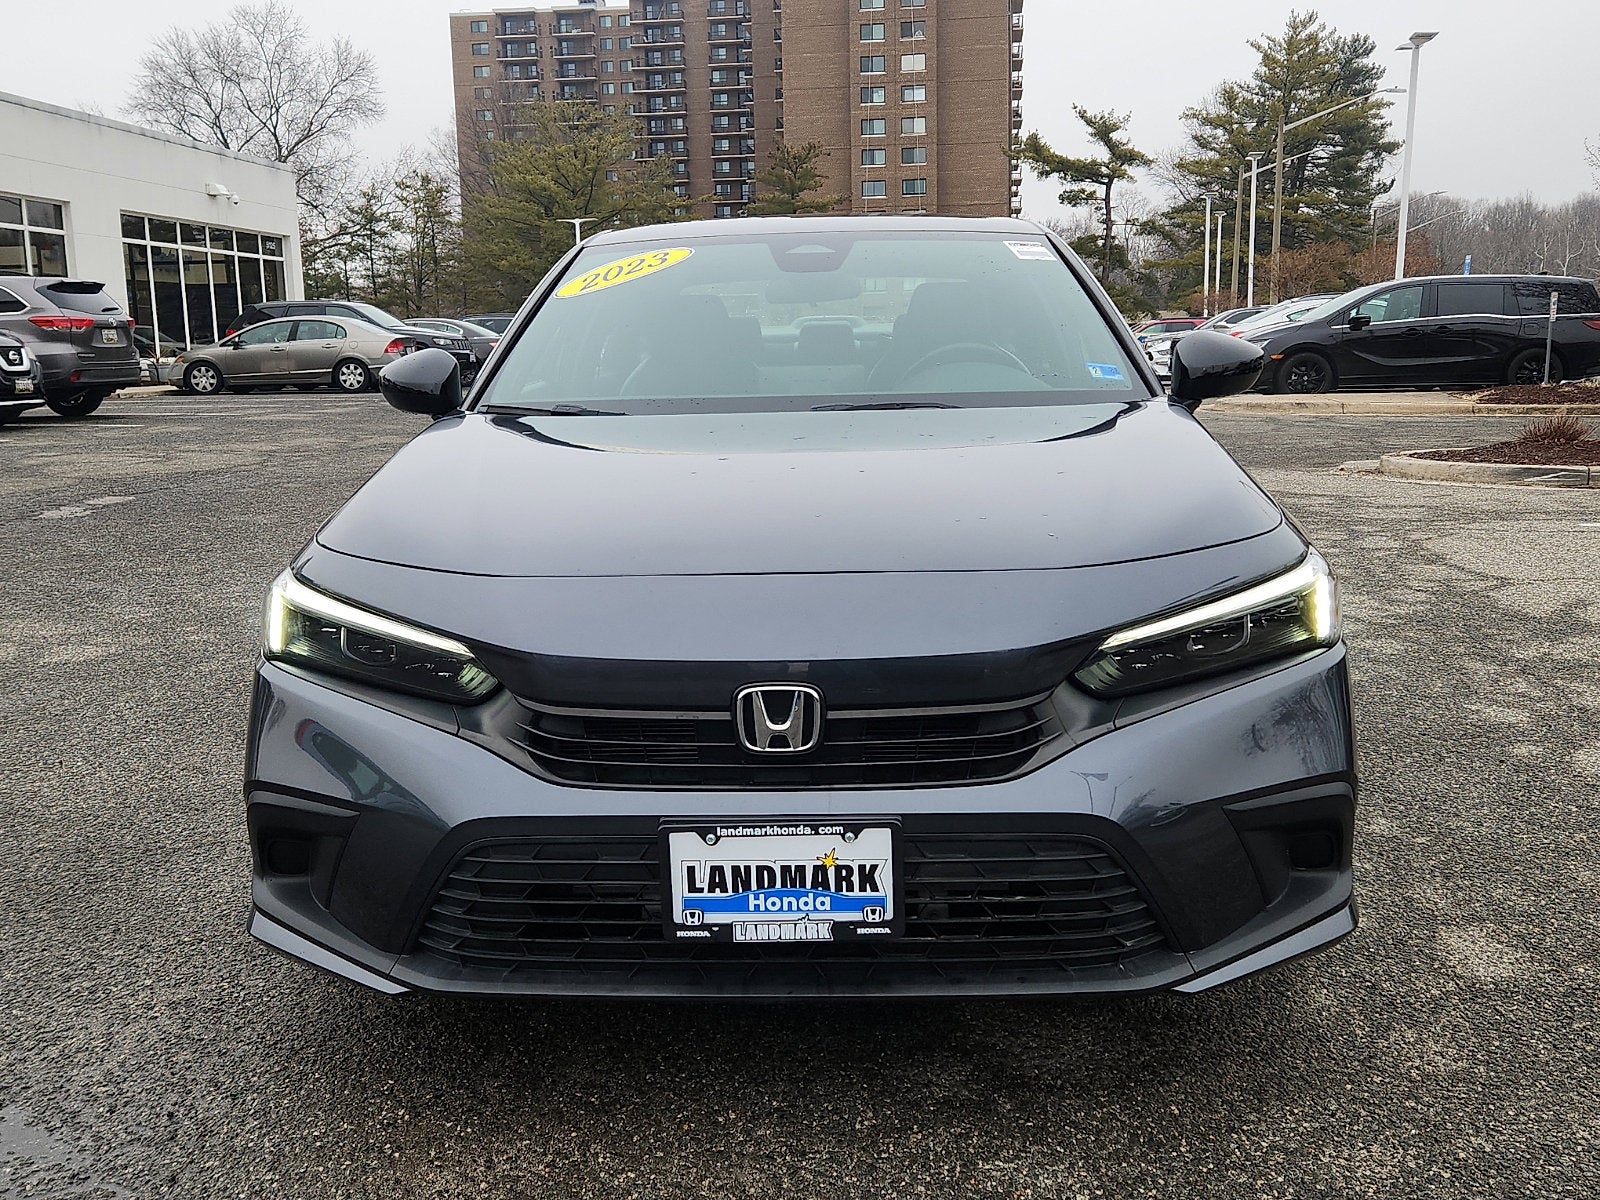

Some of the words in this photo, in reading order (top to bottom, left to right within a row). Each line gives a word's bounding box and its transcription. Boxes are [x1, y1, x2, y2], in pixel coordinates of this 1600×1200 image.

[580, 252, 669, 291] 2023
[686, 864, 880, 894] LANDMARK
[749, 893, 831, 911] Honda
[676, 930, 711, 938] HONDA
[735, 922, 832, 941] LANDMARK
